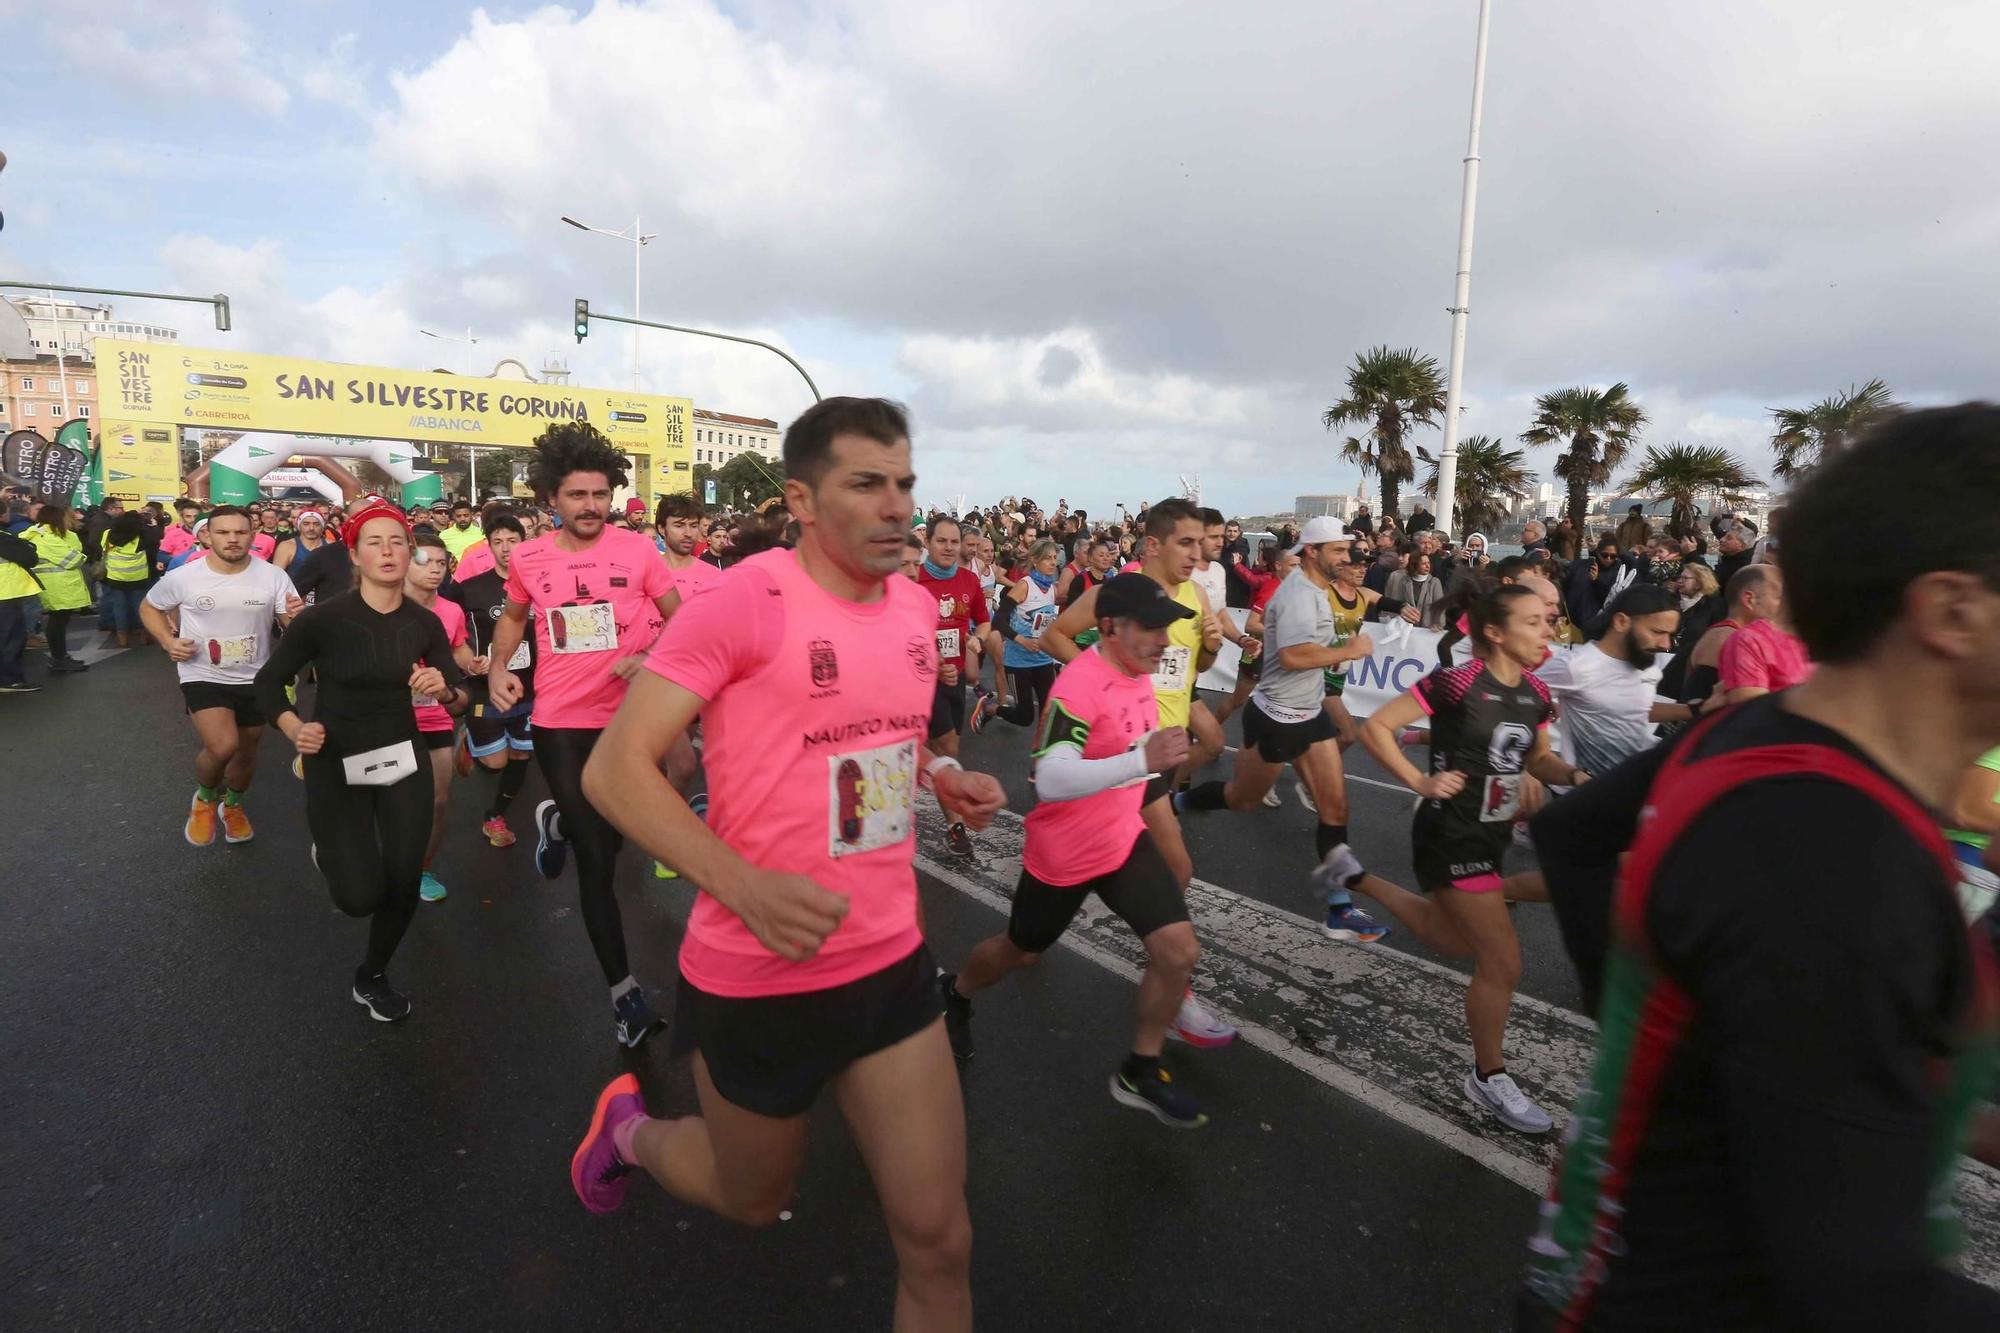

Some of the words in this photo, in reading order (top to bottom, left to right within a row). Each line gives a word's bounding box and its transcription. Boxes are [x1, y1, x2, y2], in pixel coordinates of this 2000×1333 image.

[118, 351, 150, 364] SAN
[119, 364, 151, 378] SIL
[120, 377, 152, 391] VES
[121, 390, 152, 403] TRE
[275, 374, 334, 401] SAN
[347, 379, 489, 413] SILVESTRE
[500, 394, 588, 422] CORUÑA
[666, 404, 684, 414] SAN
[666, 414, 684, 424] SIL
[666, 425, 684, 434] VES
[666, 434, 684, 443] TRE
[42, 450, 61, 495] CASTRO
[707, 481, 715, 491] P
[802, 718, 882, 749] NAUTICO
